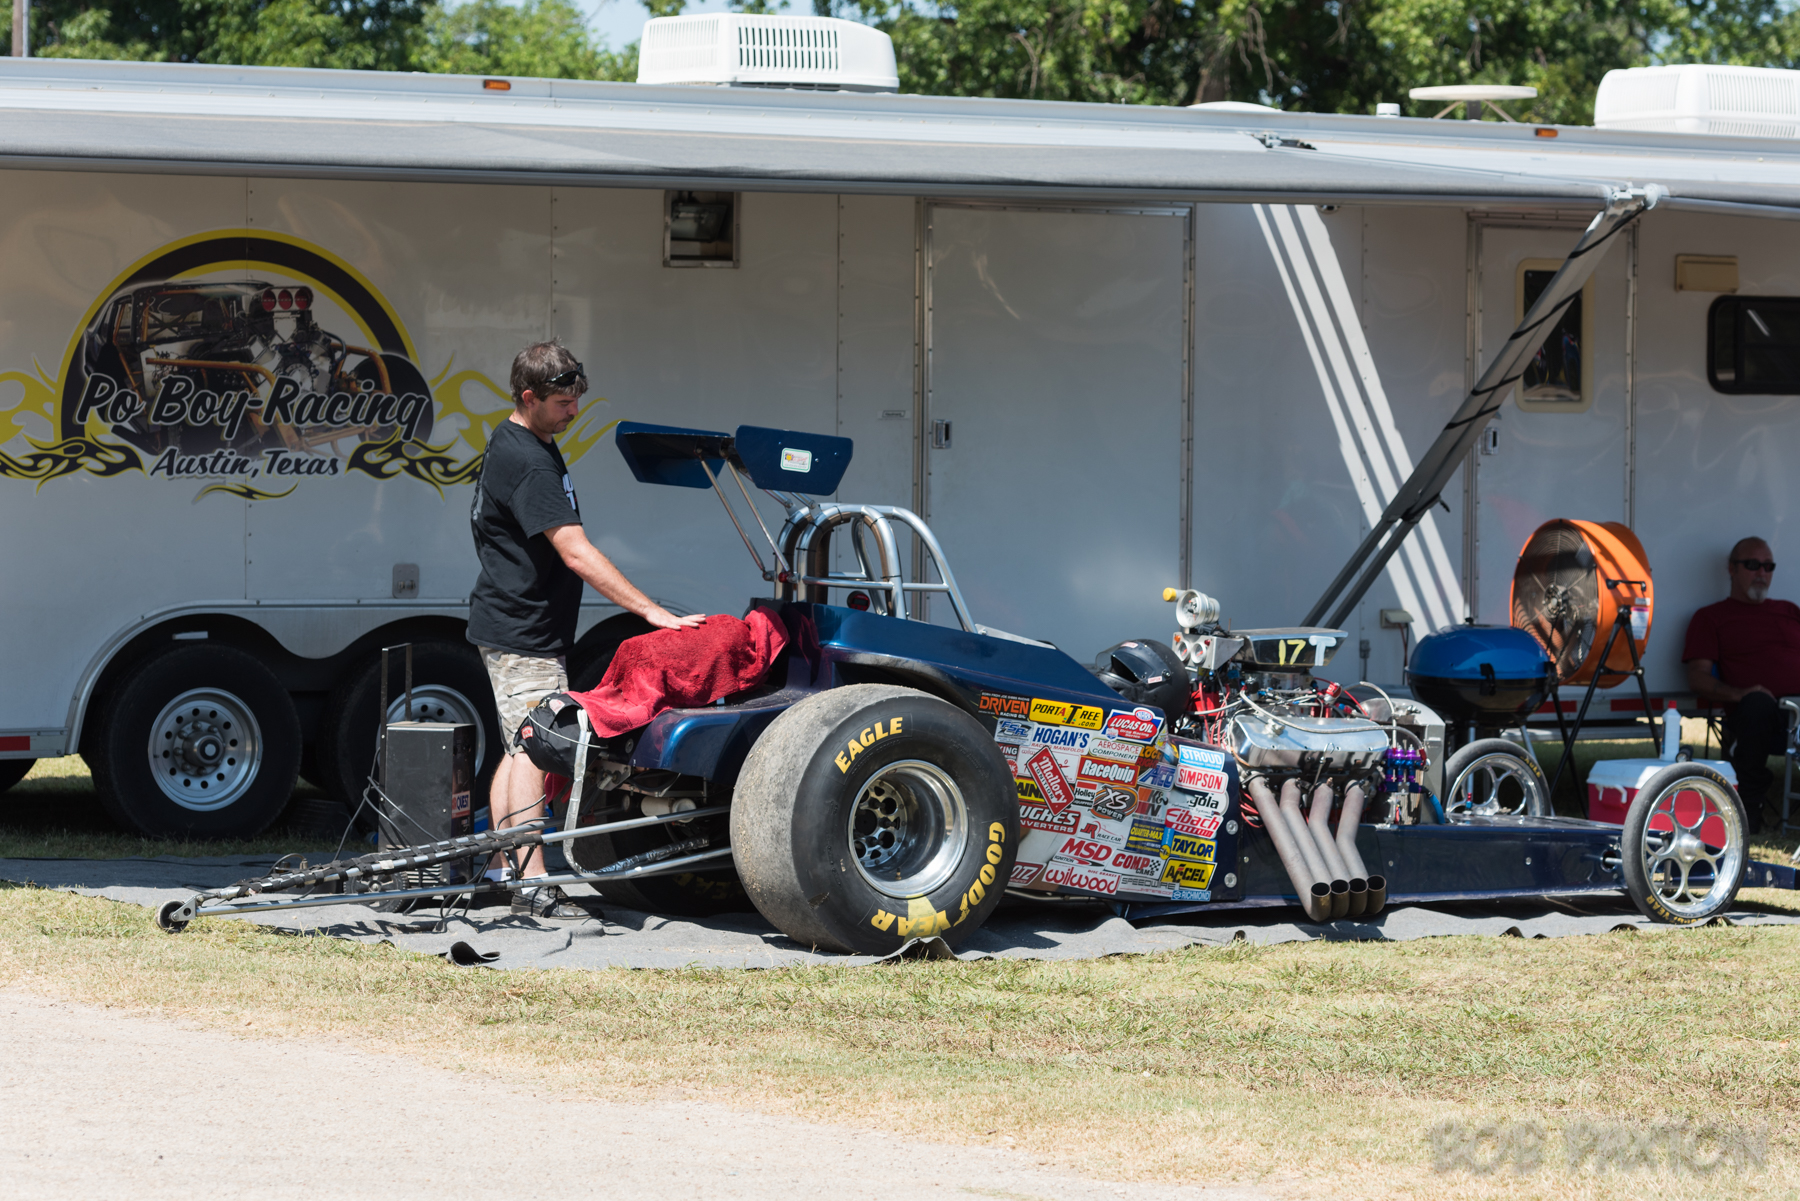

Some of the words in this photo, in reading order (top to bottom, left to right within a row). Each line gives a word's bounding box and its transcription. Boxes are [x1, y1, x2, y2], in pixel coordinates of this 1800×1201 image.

[76, 373, 145, 425] Po
[150, 446, 260, 479] Austin,
[262, 447, 340, 476] Texas
[979, 695, 1029, 715] DRIVEN
[1110, 718, 1141, 730] LUCAS
[1139, 722, 1154, 733] OIL
[834, 717, 903, 774] EAGLE
[1033, 727, 1090, 748] HOGAN'S
[1098, 740, 1140, 754] AEROSPACE
[1181, 748, 1223, 764] STROUD
[1039, 756, 1067, 802] Mallory
[1081, 759, 1135, 783] RaceQuip
[1178, 768, 1223, 790] SIMPSON
[1075, 788, 1095, 800] Holley
[1019, 805, 1080, 826] UGHES
[1097, 805, 1123, 820] POWER
[1167, 807, 1220, 831] Eibach
[1020, 820, 1074, 833] NVERTERS
[1060, 838, 1112, 861] MSD
[1172, 837, 1214, 858] TAYLOR
[1054, 855, 1074, 863] IGNITION
[1112, 853, 1150, 870] COMP
[1045, 866, 1120, 894] wilwood
[1136, 868, 1155, 876] CAMS
[1165, 863, 1205, 882] ACCEL
[1181, 890, 1211, 900] RICHMOND
